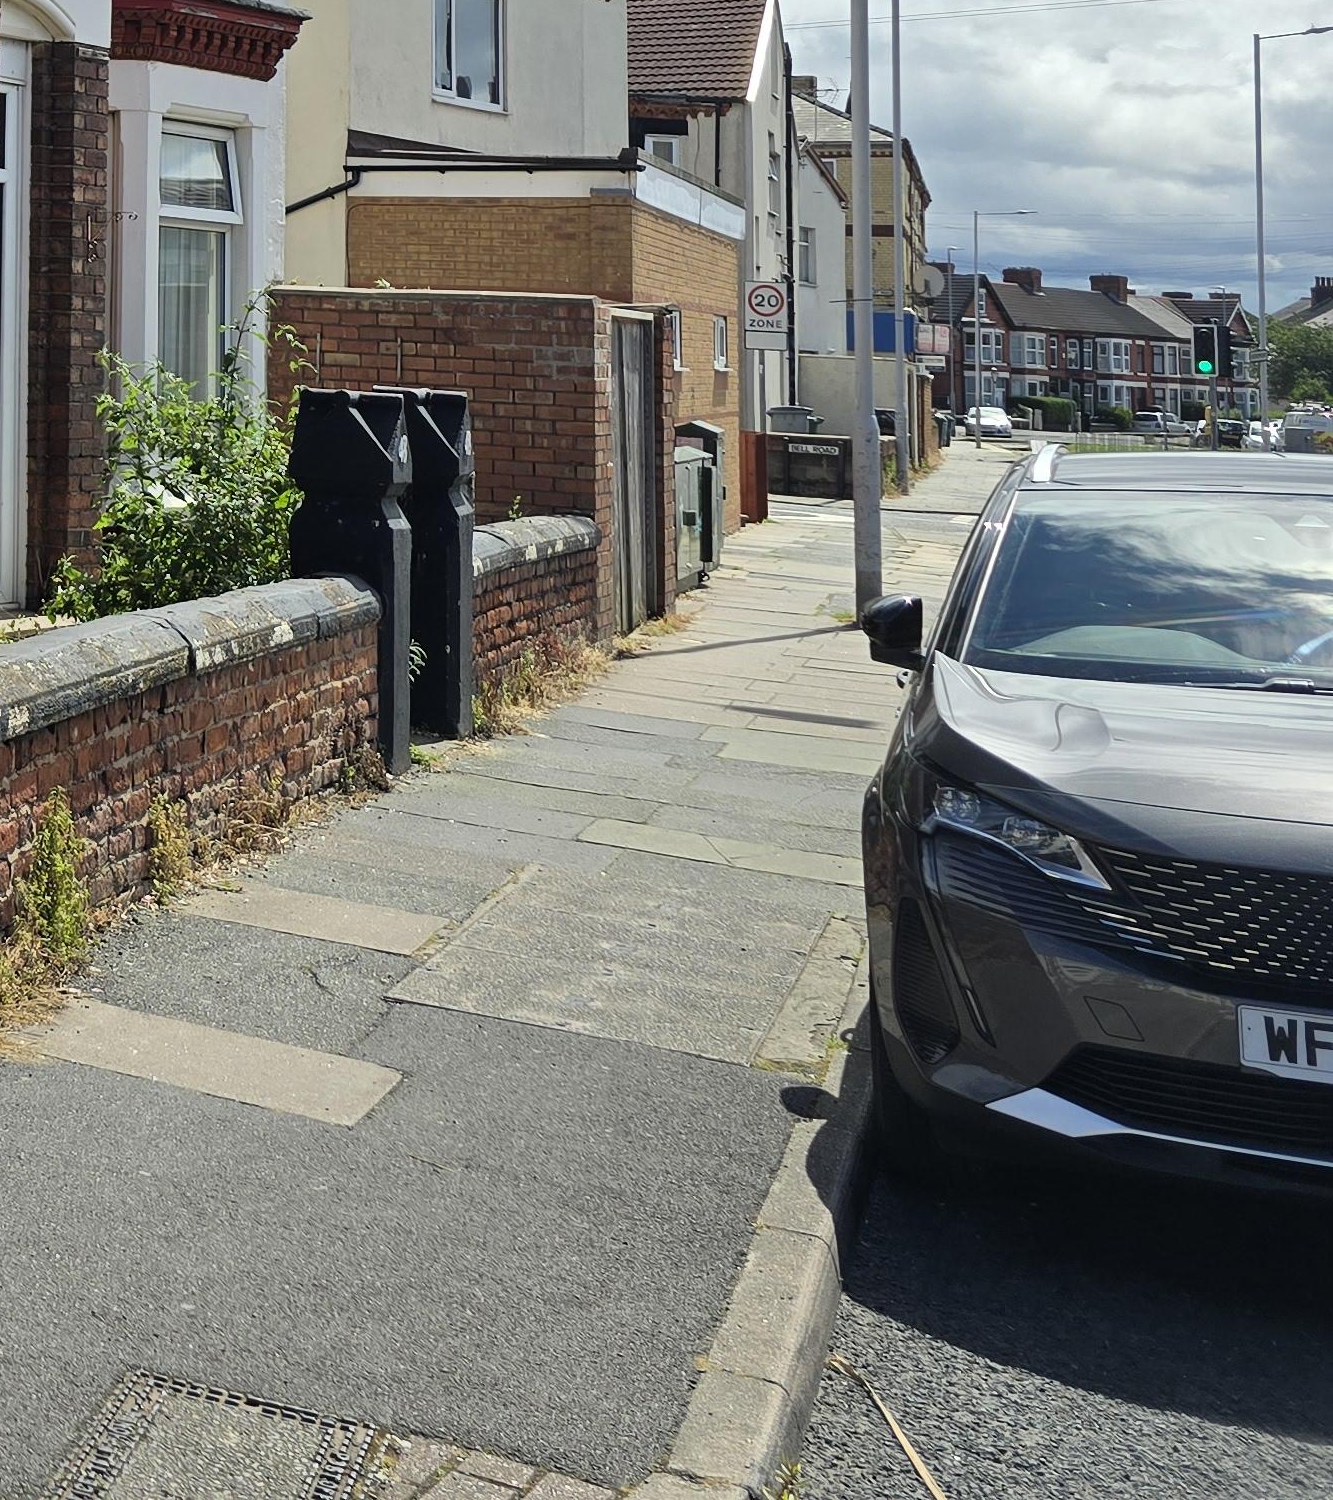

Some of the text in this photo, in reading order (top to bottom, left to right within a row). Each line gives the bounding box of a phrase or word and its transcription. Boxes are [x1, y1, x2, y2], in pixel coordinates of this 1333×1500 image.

[754, 294, 779, 308] 20
[749, 319, 782, 328] ZONE
[1263, 1015, 1333, 1067] WF
